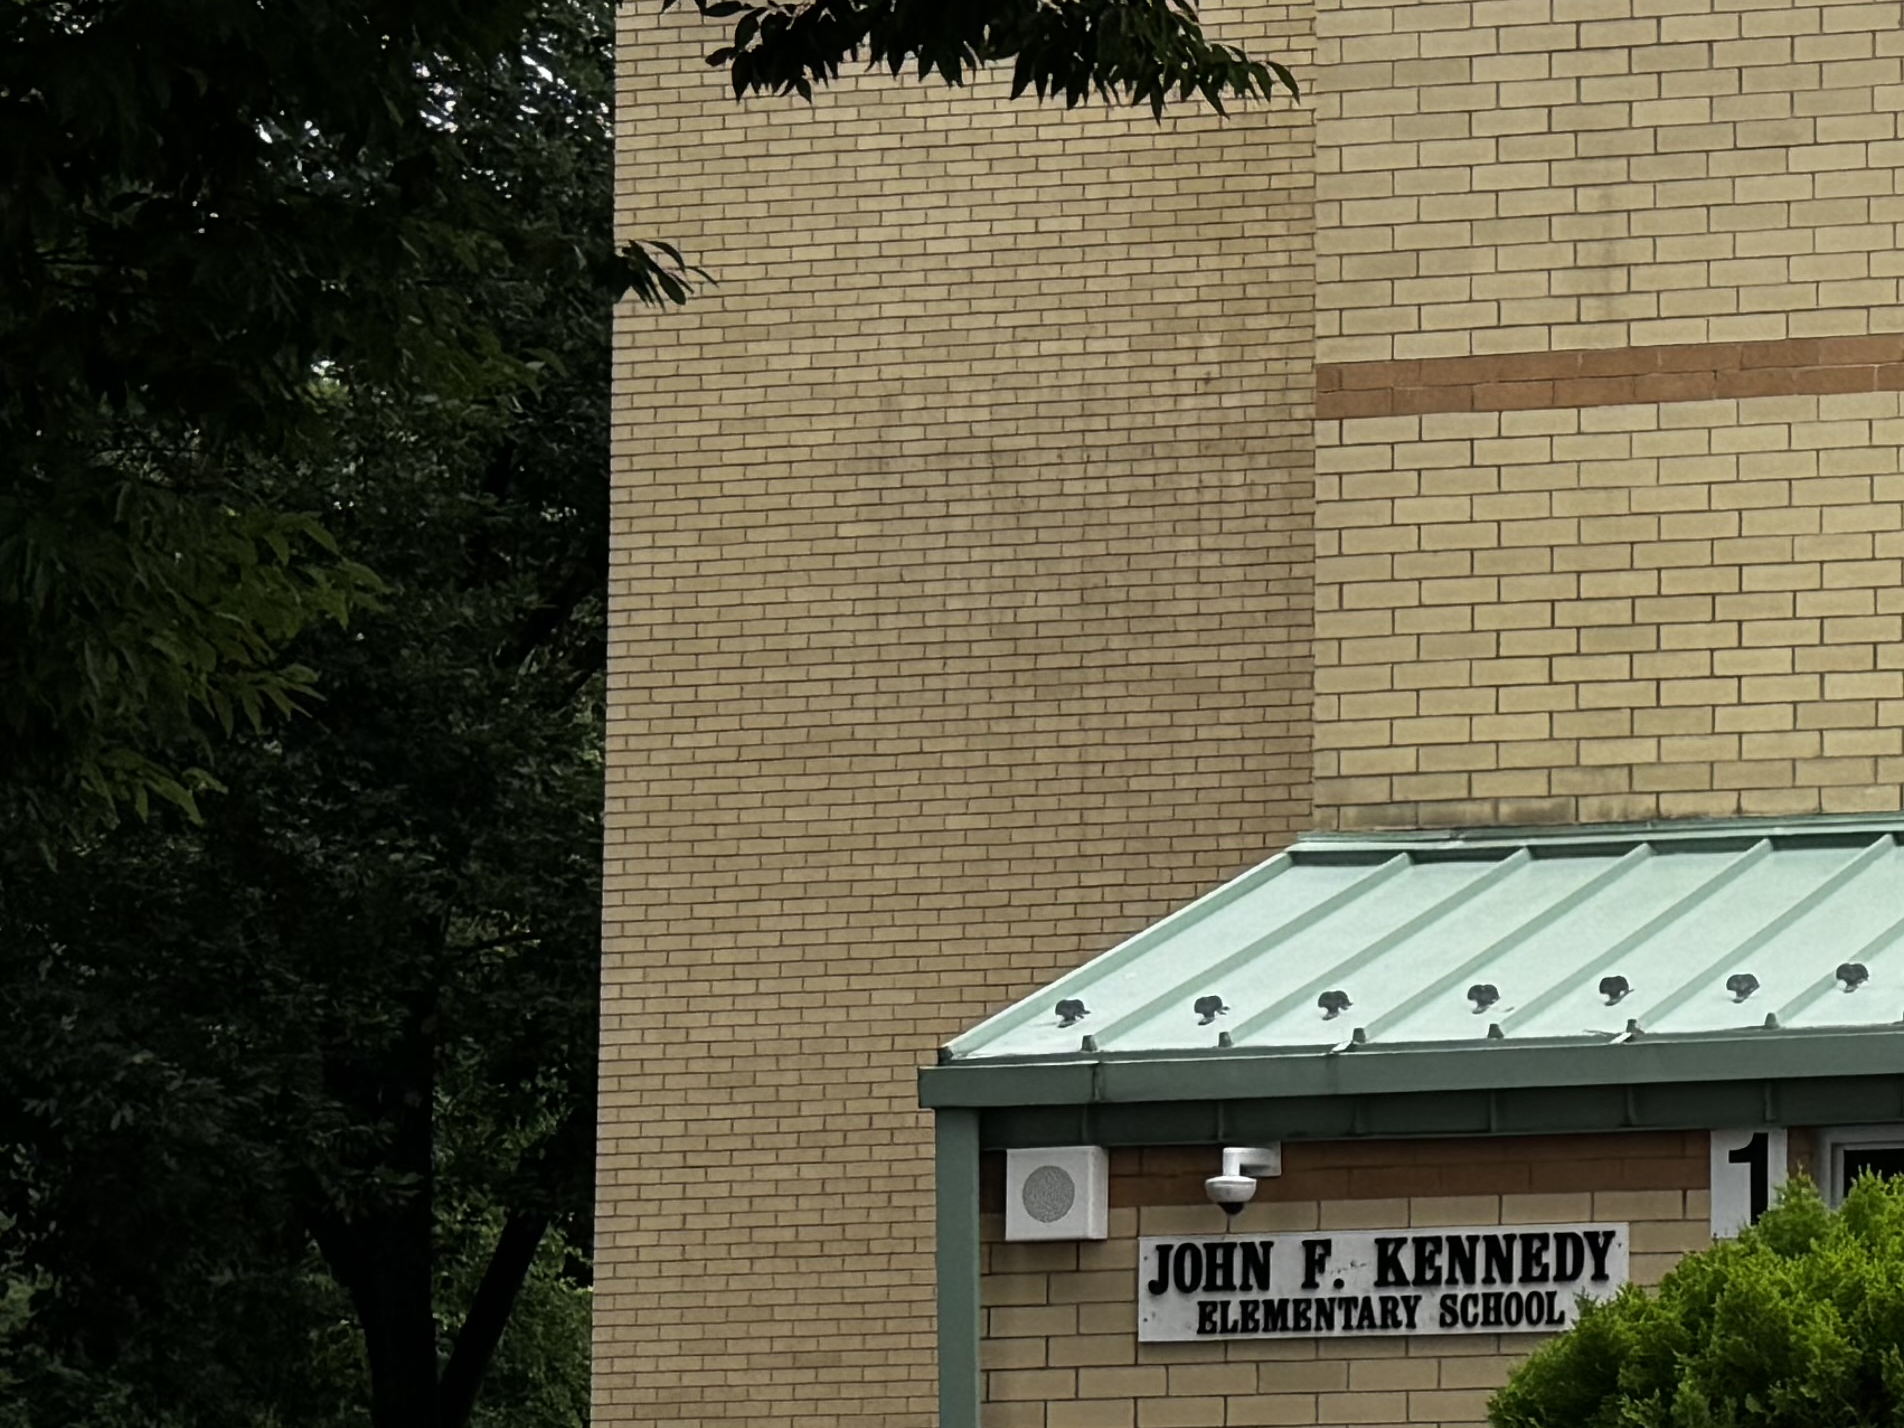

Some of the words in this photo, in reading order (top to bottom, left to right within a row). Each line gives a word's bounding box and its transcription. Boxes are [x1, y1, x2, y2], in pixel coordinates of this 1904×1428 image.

[1727, 1132, 1769, 1227] 1
[1146, 1239, 1274, 1298] JOHN
[1300, 1238, 1346, 1291] F.
[1373, 1229, 1618, 1290] KENNEDY
[1196, 1293, 1420, 1336] ELEMENTARY
[1437, 1290, 1566, 1329] SCHOOL
